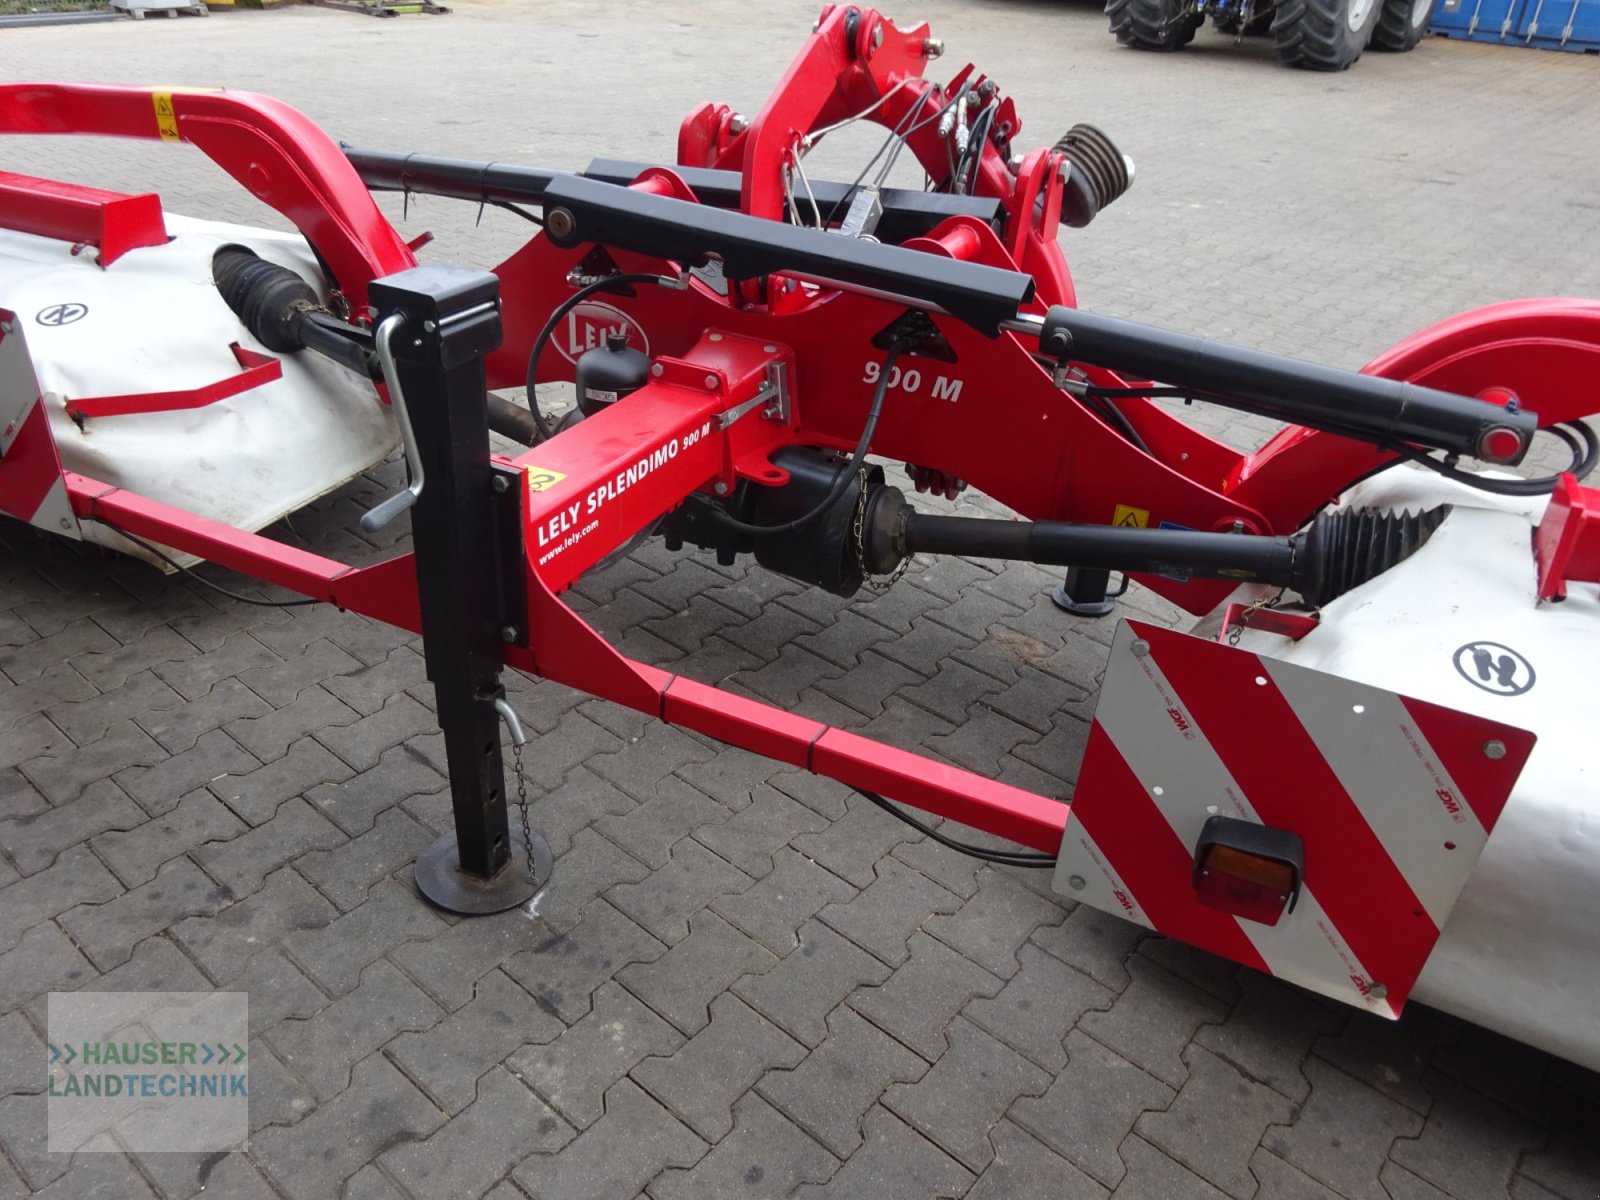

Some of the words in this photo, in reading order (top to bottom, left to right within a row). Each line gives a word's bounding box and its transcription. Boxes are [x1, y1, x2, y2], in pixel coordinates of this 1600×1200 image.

[931, 375, 964, 402] M
[538, 501, 580, 547] LELY
[587, 439, 678, 514] SPLENDIMO
[683, 429, 699, 450] 900
[701, 422, 710, 438] M
[539, 519, 599, 565] www.lely.com
[1167, 707, 1189, 731] WGF
[1436, 789, 1460, 814] WGF
[1113, 889, 1133, 910] WGF
